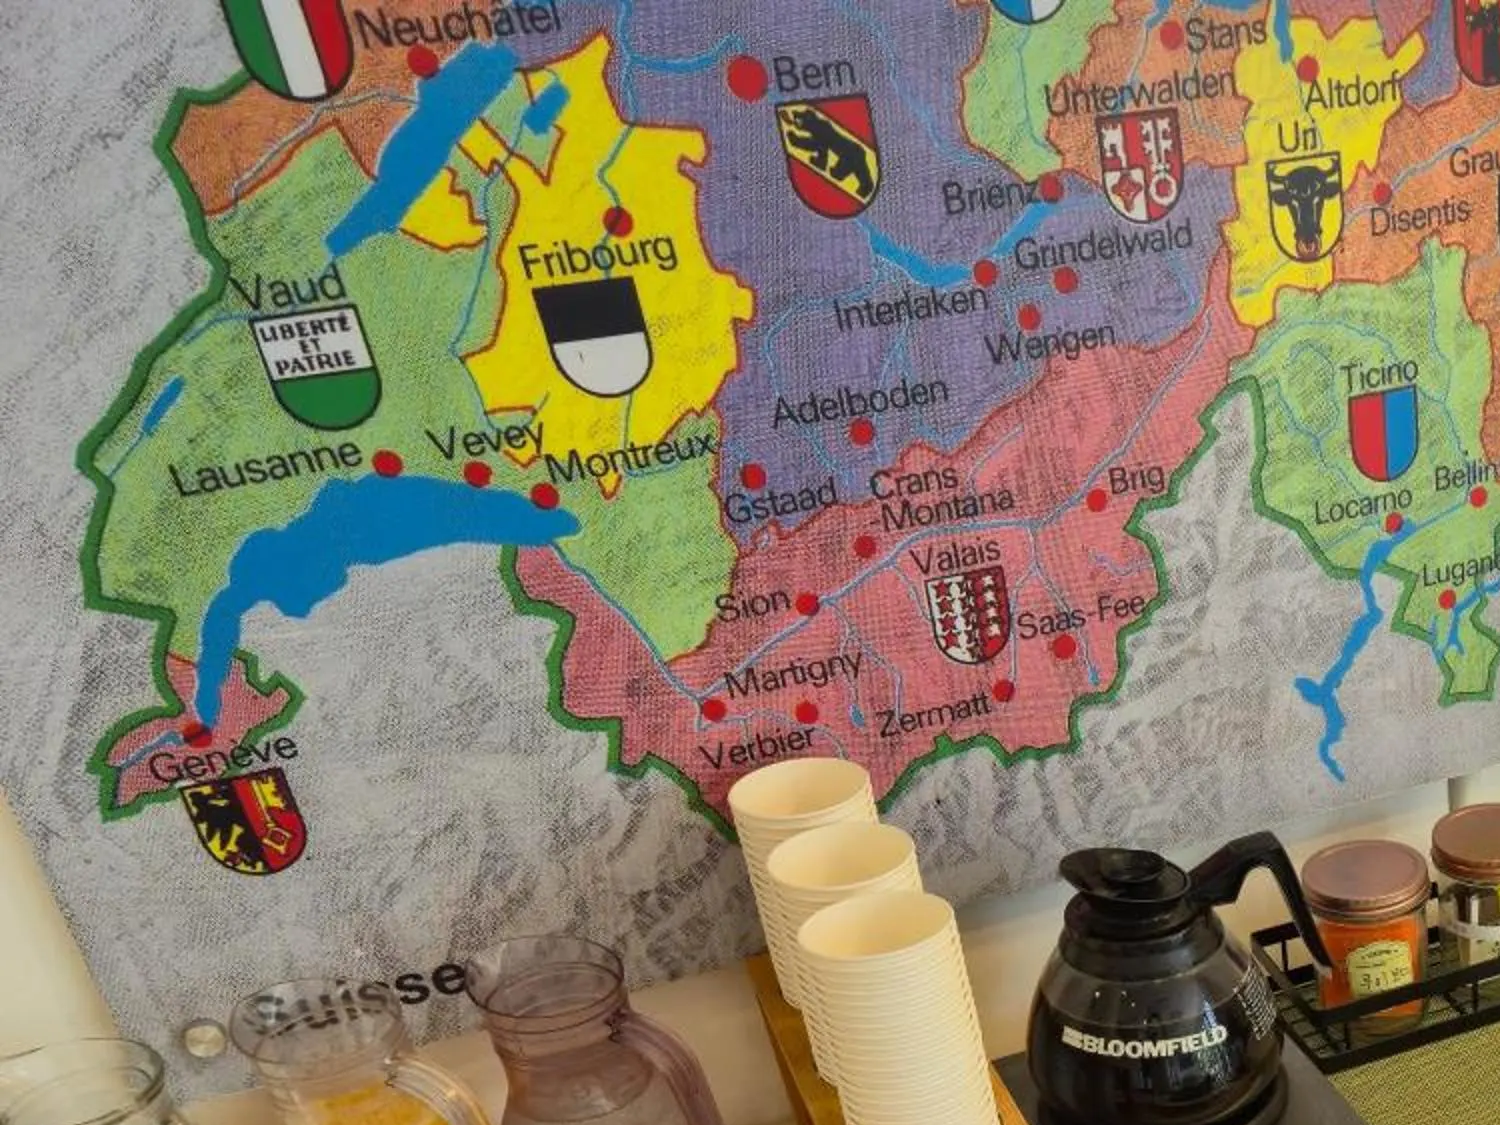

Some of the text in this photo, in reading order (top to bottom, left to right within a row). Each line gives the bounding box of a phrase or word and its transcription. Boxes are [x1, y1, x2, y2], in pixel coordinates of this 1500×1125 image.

[1186, 17, 1267, 51] Stans
[774, 56, 856, 93] Bern
[1044, 70, 1237, 117] Unterwalden
[1306, 75, 1402, 110] Altdorf
[1278, 122, 1319, 154] Uri
[944, 178, 1038, 215] Brienz
[1370, 197, 1471, 237] Disentis
[518, 236, 678, 280] Fribourg
[1014, 223, 1193, 270] Grindelwald
[232, 270, 346, 312] Vaud
[834, 285, 988, 333] Interlaken
[275, 350, 355, 375] PATRIE
[299, 338, 320, 354] ET
[984, 320, 1116, 365] Wengen
[1340, 355, 1418, 393] Ticino
[771, 378, 949, 430] Adelboden
[426, 420, 545, 462] Vevey
[547, 431, 718, 486] Montreux
[168, 439, 363, 498] Lausanne
[870, 467, 958, 500] Crans
[1108, 464, 1165, 501] Brig
[725, 476, 838, 523] Gstaad
[1314, 487, 1413, 525] Locarno
[909, 537, 1001, 574] Valais
[714, 587, 791, 624] Sion
[1017, 594, 1146, 639] Saas-Fee
[724, 650, 862, 699] Martigny
[876, 692, 993, 739] Zermatt
[150, 736, 298, 785] Genève
[700, 727, 815, 771] Verbier
[1082, 1030, 1228, 1059] BLOOMFIELD
